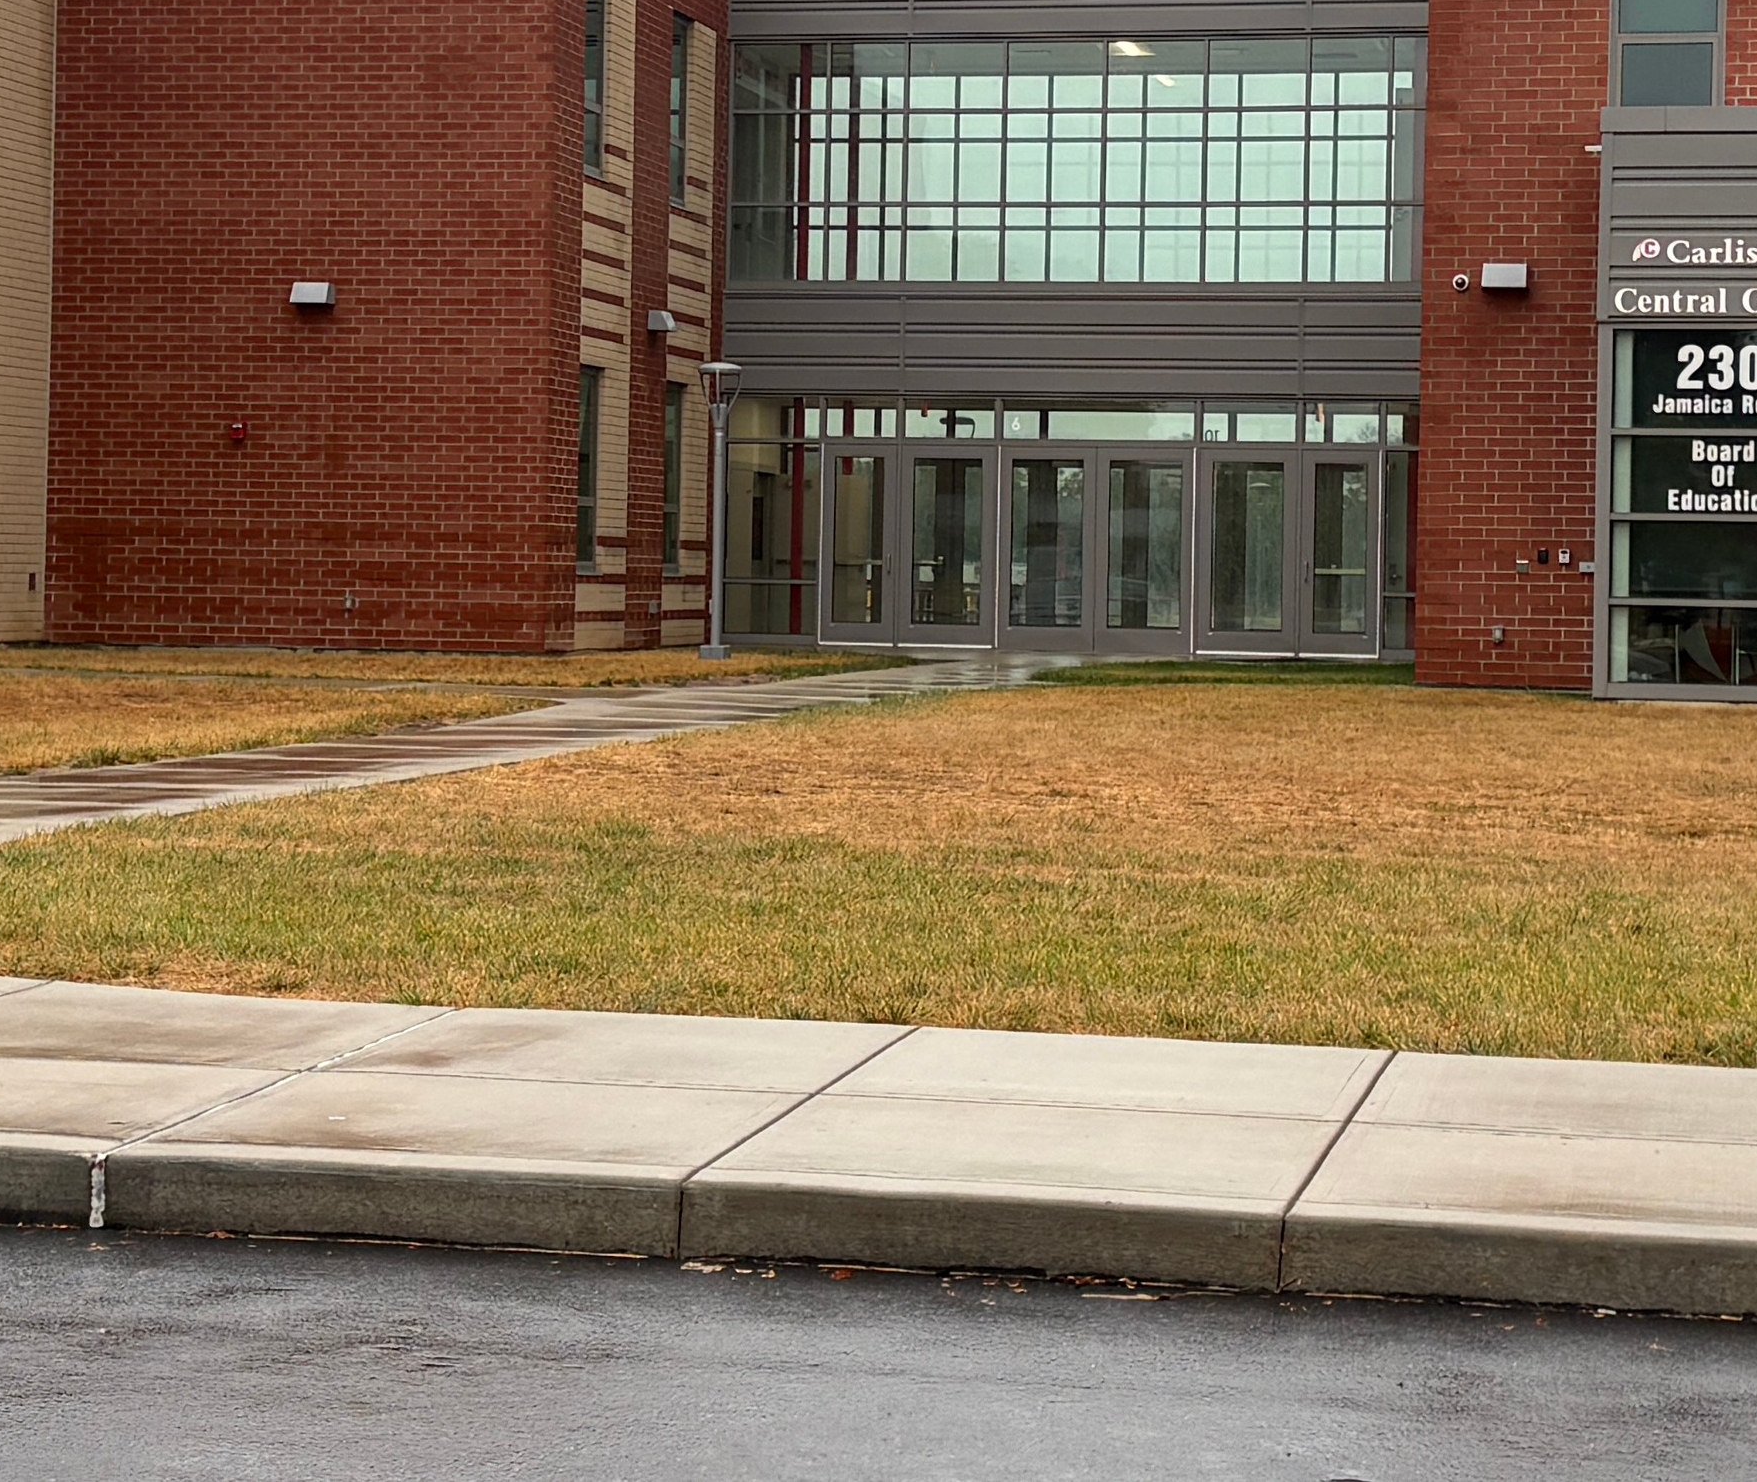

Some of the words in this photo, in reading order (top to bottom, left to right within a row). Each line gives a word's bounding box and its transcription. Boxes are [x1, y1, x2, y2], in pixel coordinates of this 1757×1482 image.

[1614, 287, 1728, 314] Central
[1652, 393, 1734, 414] Jamaica
[1011, 416, 1021, 431] 6
[1692, 439, 1756, 462] Board
[1711, 464, 1736, 488] Of
